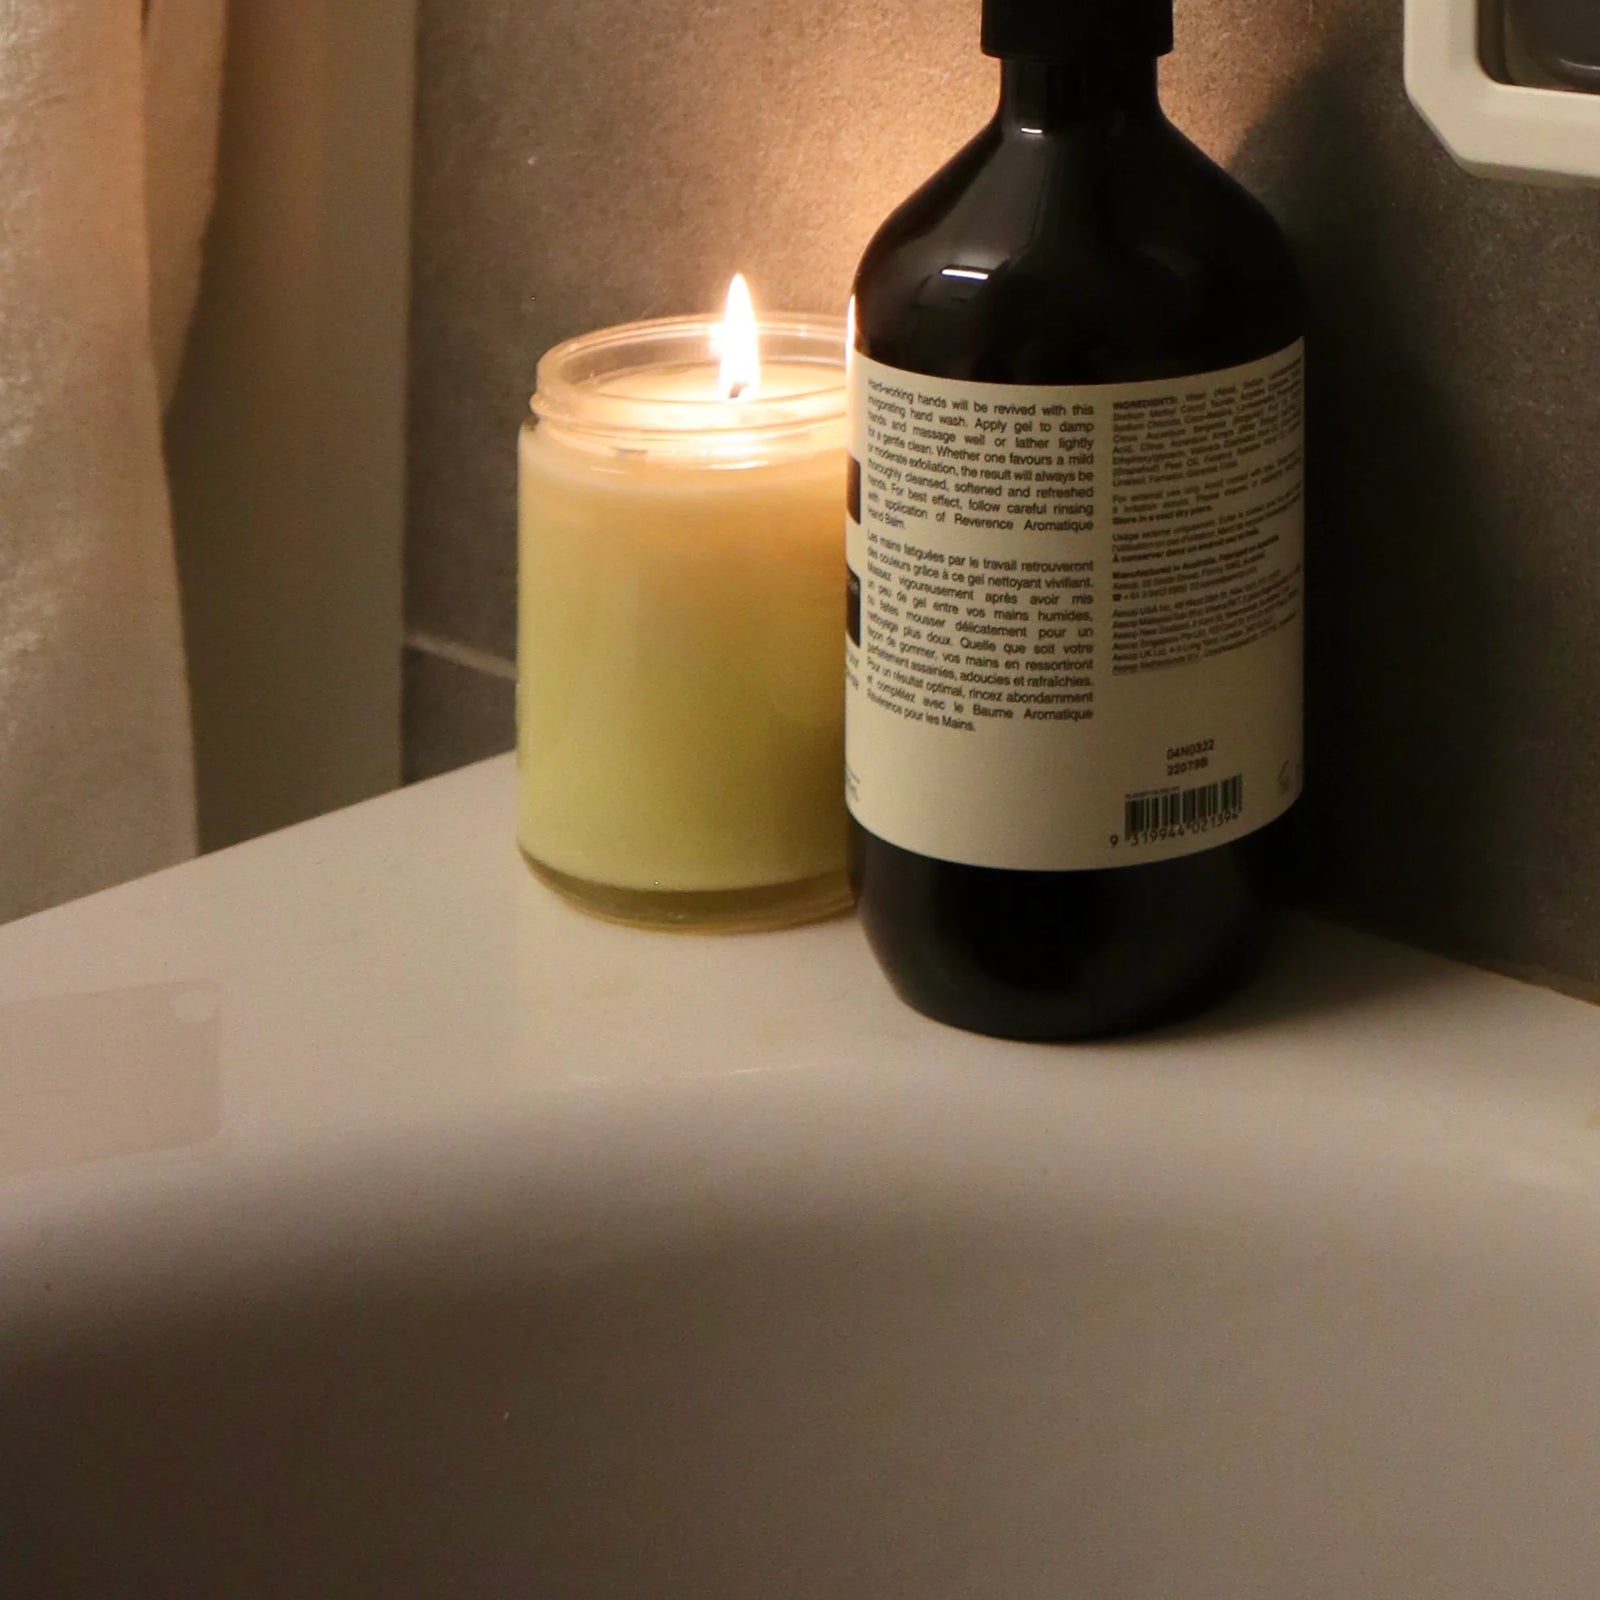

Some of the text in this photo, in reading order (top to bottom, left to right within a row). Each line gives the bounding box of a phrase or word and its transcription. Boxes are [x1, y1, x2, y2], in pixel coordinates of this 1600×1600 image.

[917, 392, 947, 408] hands
[952, 399, 968, 410] will
[974, 401, 988, 413] be
[994, 402, 1035, 415] revived
[1042, 404, 1066, 416] with
[1072, 403, 1094, 416] this
[891, 419, 907, 433] and
[913, 426, 956, 443] massage
[964, 434, 985, 446] well
[994, 437, 1006, 447] or
[1016, 437, 1048, 448] lather
[1059, 437, 1094, 450] lightly
[910, 407, 933, 422] hand
[939, 415, 968, 427] wash.
[975, 418, 1007, 433] Apply
[1014, 421, 1032, 434] gel
[1040, 421, 1051, 432] to
[1059, 421, 1094, 433] damp
[908, 440, 933, 455] clean.
[936, 445, 980, 461] Whether
[984, 453, 1005, 463] one
[1009, 452, 1052, 465] favours
[1057, 456, 1064, 465] a
[1069, 453, 1094, 465] mild
[909, 456, 958, 475] exfoliation,
[961, 467, 977, 478] the
[980, 468, 1011, 480] result
[1014, 470, 1032, 480] will
[1035, 472, 1075, 484] always
[1078, 471, 1093, 482] be
[891, 482, 904, 497] For
[908, 489, 927, 502] best
[932, 494, 962, 510] effect,
[969, 499, 1000, 512] follow
[1007, 501, 1046, 514] careful
[1053, 502, 1093, 516] rinsing
[905, 473, 949, 491] cleansed,
[954, 482, 1001, 496] softened
[1008, 485, 1029, 497] and
[1037, 486, 1093, 498] refreshed
[885, 498, 928, 519] application
[935, 511, 946, 522] of
[954, 513, 1013, 529] Reverence
[1024, 518, 1093, 532] Aromatique
[913, 563, 939, 580] grâce
[942, 569, 949, 581] à
[952, 572, 964, 582] ce
[968, 573, 984, 586] gel
[988, 575, 1041, 590] nettoyant
[1045, 576, 1093, 588] vivifiant.
[948, 554, 965, 567] par
[969, 556, 979, 569] le
[983, 558, 1017, 570] travail
[1021, 560, 1093, 572] retrouveront
[898, 575, 974, 600] vigoureusement
[985, 590, 1018, 605] après
[1030, 593, 1059, 605] avoir
[1072, 594, 1093, 605] mis
[897, 590, 907, 602] de
[913, 596, 926, 609] gel
[933, 601, 959, 615] entre
[966, 608, 985, 618] vos
[994, 608, 1028, 621] mains
[903, 624, 921, 641] plus
[927, 630, 952, 646] doux.
[960, 636, 996, 652] Quelle
[1003, 642, 1025, 655] que
[1034, 642, 1055, 654] soit
[1064, 642, 1093, 654] votre
[906, 611, 946, 628] mousser
[955, 619, 1026, 637] délicatement
[1039, 626, 1066, 640] pour
[1078, 627, 1093, 637] un
[899, 641, 937, 661] gommer,
[942, 652, 960, 664] vos
[966, 654, 999, 668] mains
[1005, 659, 1019, 669] en
[1026, 657, 1093, 670] ressortiront
[882, 666, 892, 679] un
[926, 682, 965, 699] optimal,
[969, 689, 1002, 702] rincez
[1007, 690, 1093, 705] abondamment
[911, 661, 957, 681] assainies,
[960, 671, 1009, 686] adoucies
[1013, 674, 1023, 686] et
[1027, 672, 1093, 688] rafraîchies.
[904, 707, 923, 723] pour
[926, 711, 939, 725] les
[942, 714, 976, 732] Mains.
[922, 696, 946, 711] avec
[954, 701, 964, 713] le
[973, 704, 1013, 719] Baume
[1024, 706, 1093, 721] Aromatique
